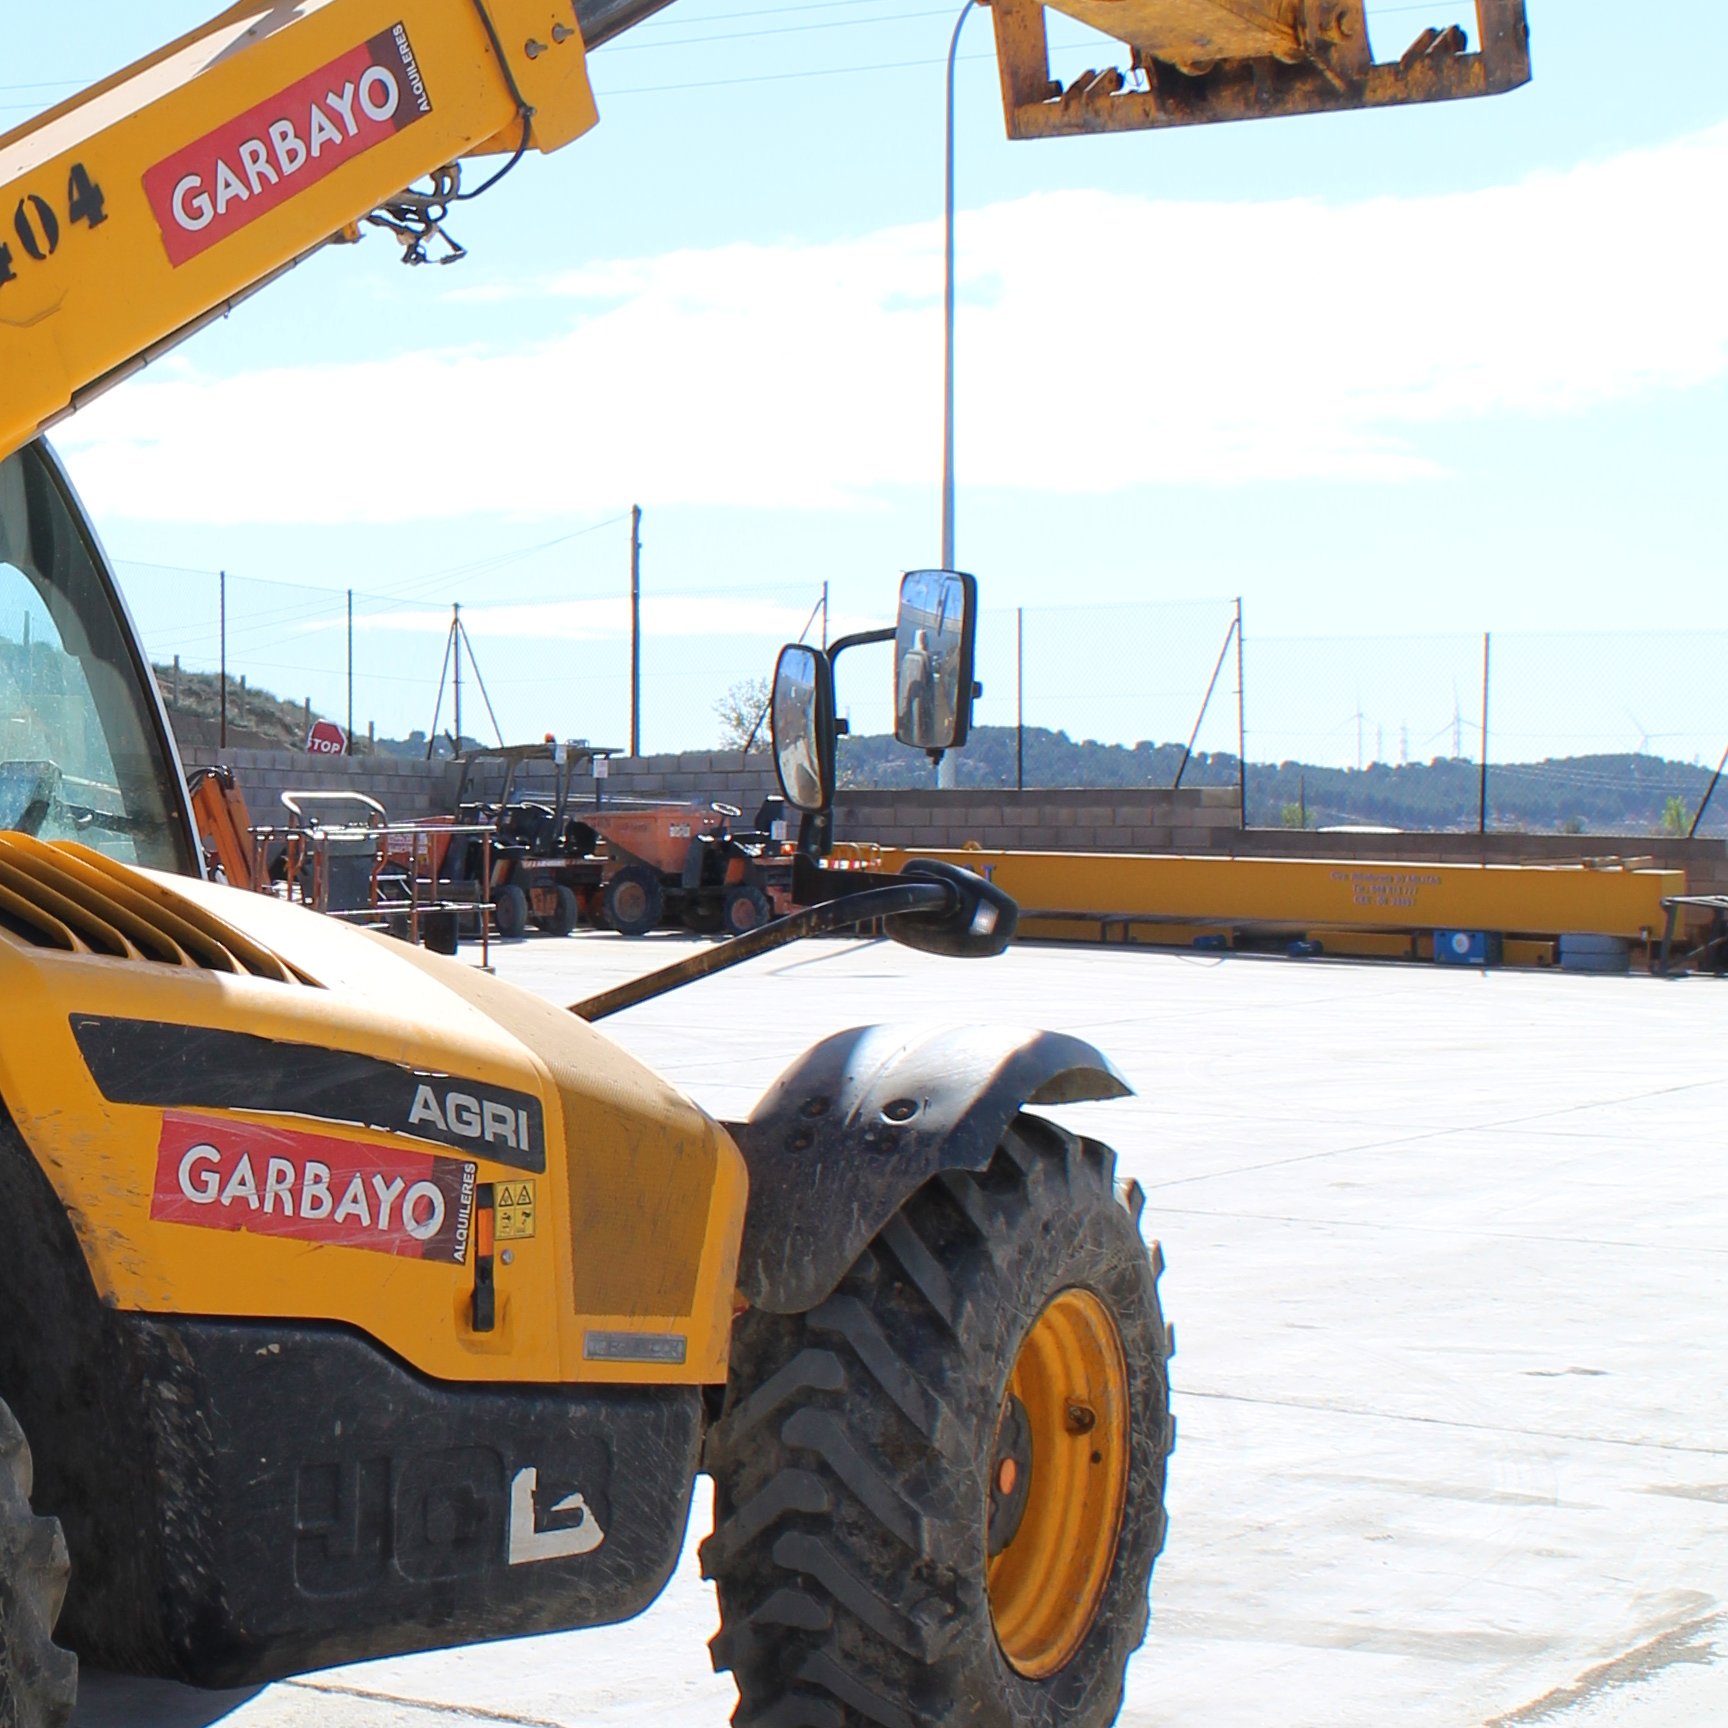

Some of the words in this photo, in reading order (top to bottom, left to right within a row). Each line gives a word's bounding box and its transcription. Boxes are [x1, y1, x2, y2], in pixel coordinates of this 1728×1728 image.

[393, 24, 430, 111] ALQUILERES
[171, 65, 400, 231] GARBAYO
[408, 1084, 528, 1152] AGRI
[178, 1143, 445, 1240] GARBAYO
[453, 1163, 476, 1262] ALQUILERES
